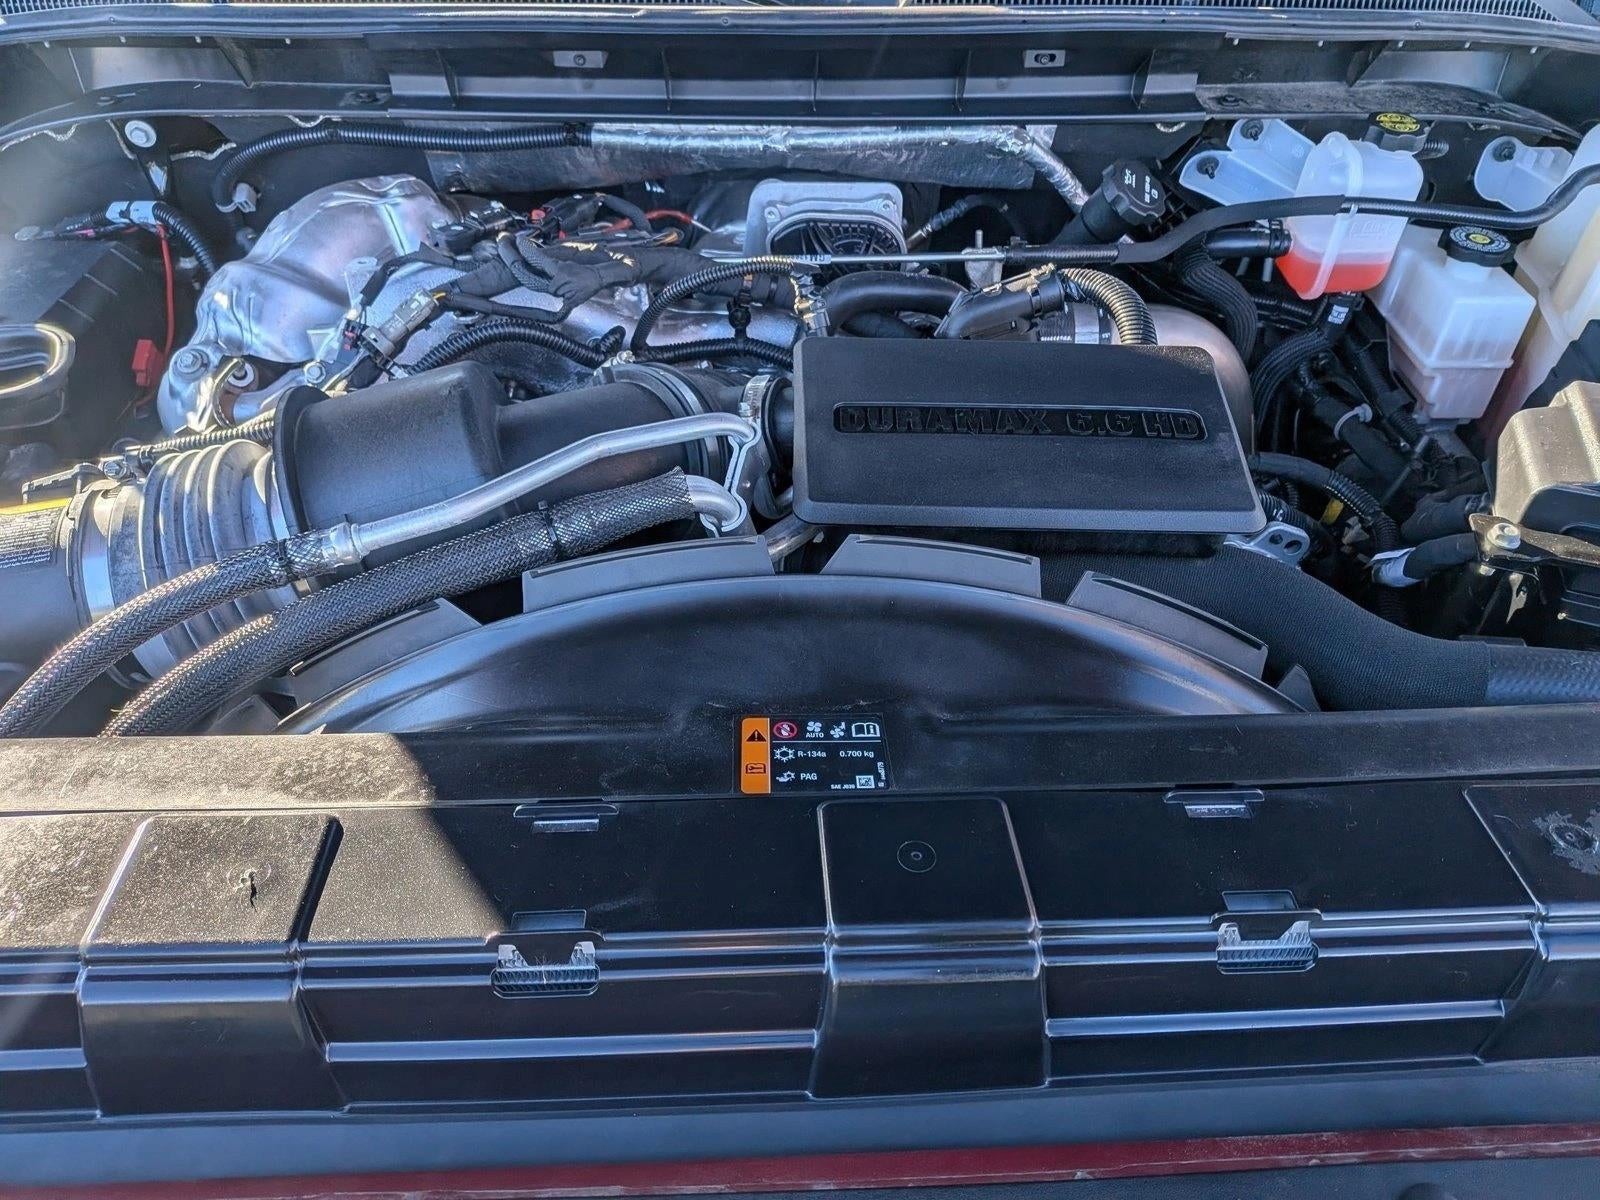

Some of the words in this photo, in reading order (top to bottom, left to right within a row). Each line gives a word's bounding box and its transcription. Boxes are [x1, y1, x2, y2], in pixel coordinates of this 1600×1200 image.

[839, 406, 1052, 435] DURAMAX
[1065, 410, 1135, 436] 6.6
[1140, 411, 1200, 439] HD
[864, 751, 875, 759] kg
[800, 772, 818, 781] PAG
